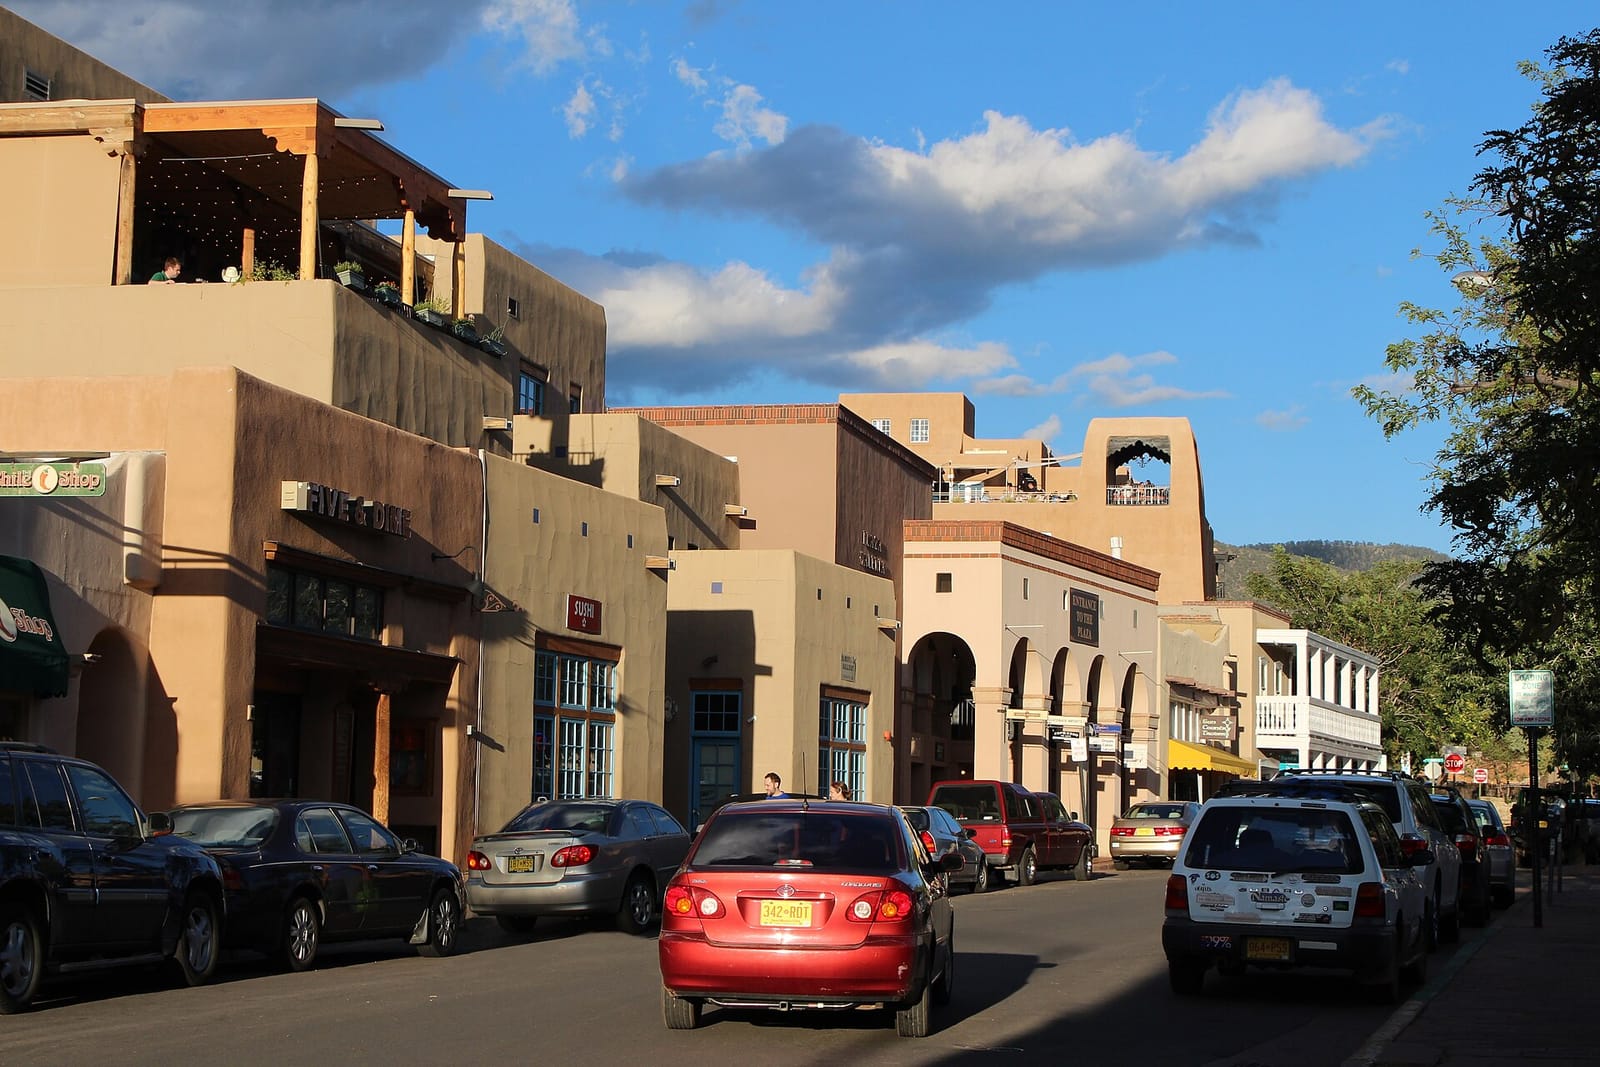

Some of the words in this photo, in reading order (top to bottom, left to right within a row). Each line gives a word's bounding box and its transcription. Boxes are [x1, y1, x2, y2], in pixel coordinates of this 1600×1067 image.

[0, 470, 32, 487] hile
[59, 471, 100, 489] Shop
[308, 481, 350, 521] FIVE
[355, 496, 367, 527] &
[373, 500, 411, 539] DIME
[574, 600, 595, 618] SUSHI
[1072, 595, 1097, 611] ENTRANCE
[10, 607, 53, 641] Shop
[1077, 611, 1083, 623] TO
[1077, 626, 1092, 640] PLAZA
[1514, 673, 1550, 681] LOADING
[1522, 682, 1541, 690] ZONE
[1446, 759, 1463, 768] STOP
[763, 905, 783, 917] 342
